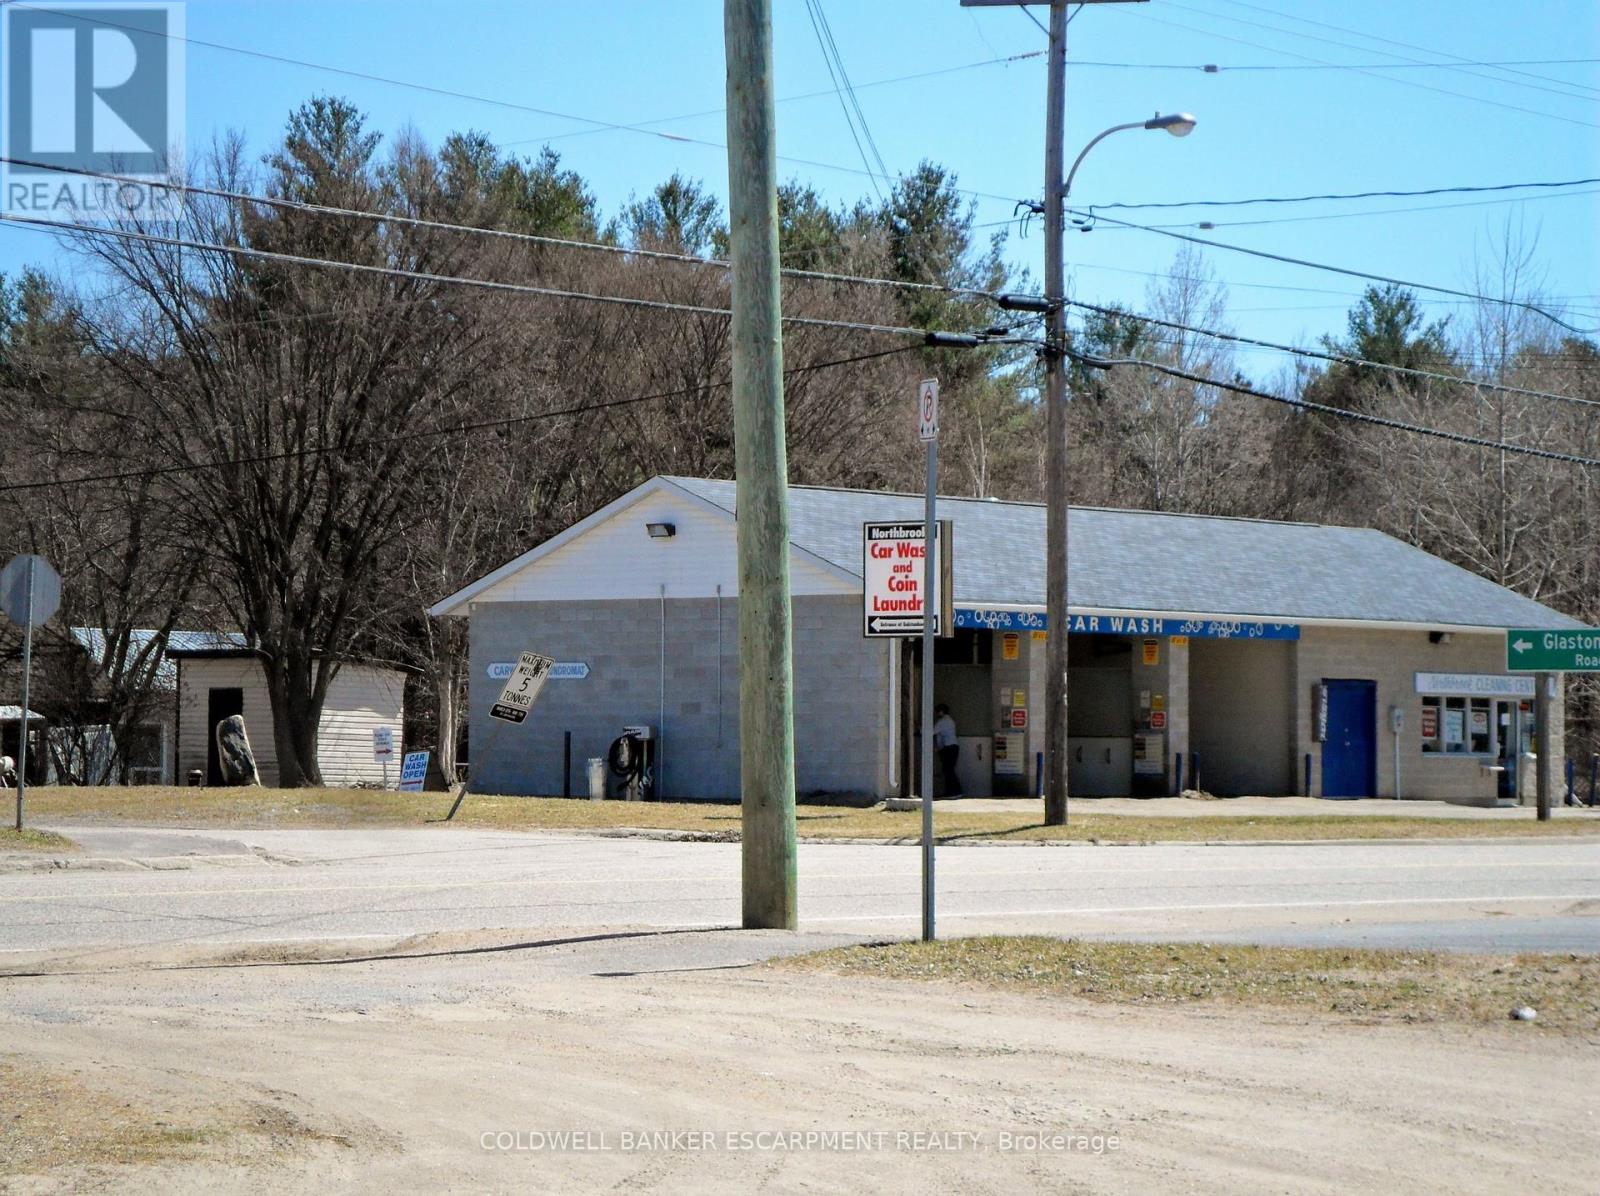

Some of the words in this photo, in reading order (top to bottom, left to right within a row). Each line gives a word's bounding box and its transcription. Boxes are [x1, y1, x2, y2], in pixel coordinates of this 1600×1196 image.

[871, 543, 893, 558] Car
[897, 542, 927, 558] Was
[893, 561, 913, 573] and
[888, 575, 917, 592] Coin
[873, 594, 924, 611] Laundr
[1110, 616, 1163, 633] WASH
[1575, 653, 1600, 666] Roa
[519, 677, 531, 692] 5
[503, 690, 531, 706] TONNES
[405, 761, 426, 770] WASH
[409, 754, 425, 762] CAR
[403, 770, 425, 779] OPEN
